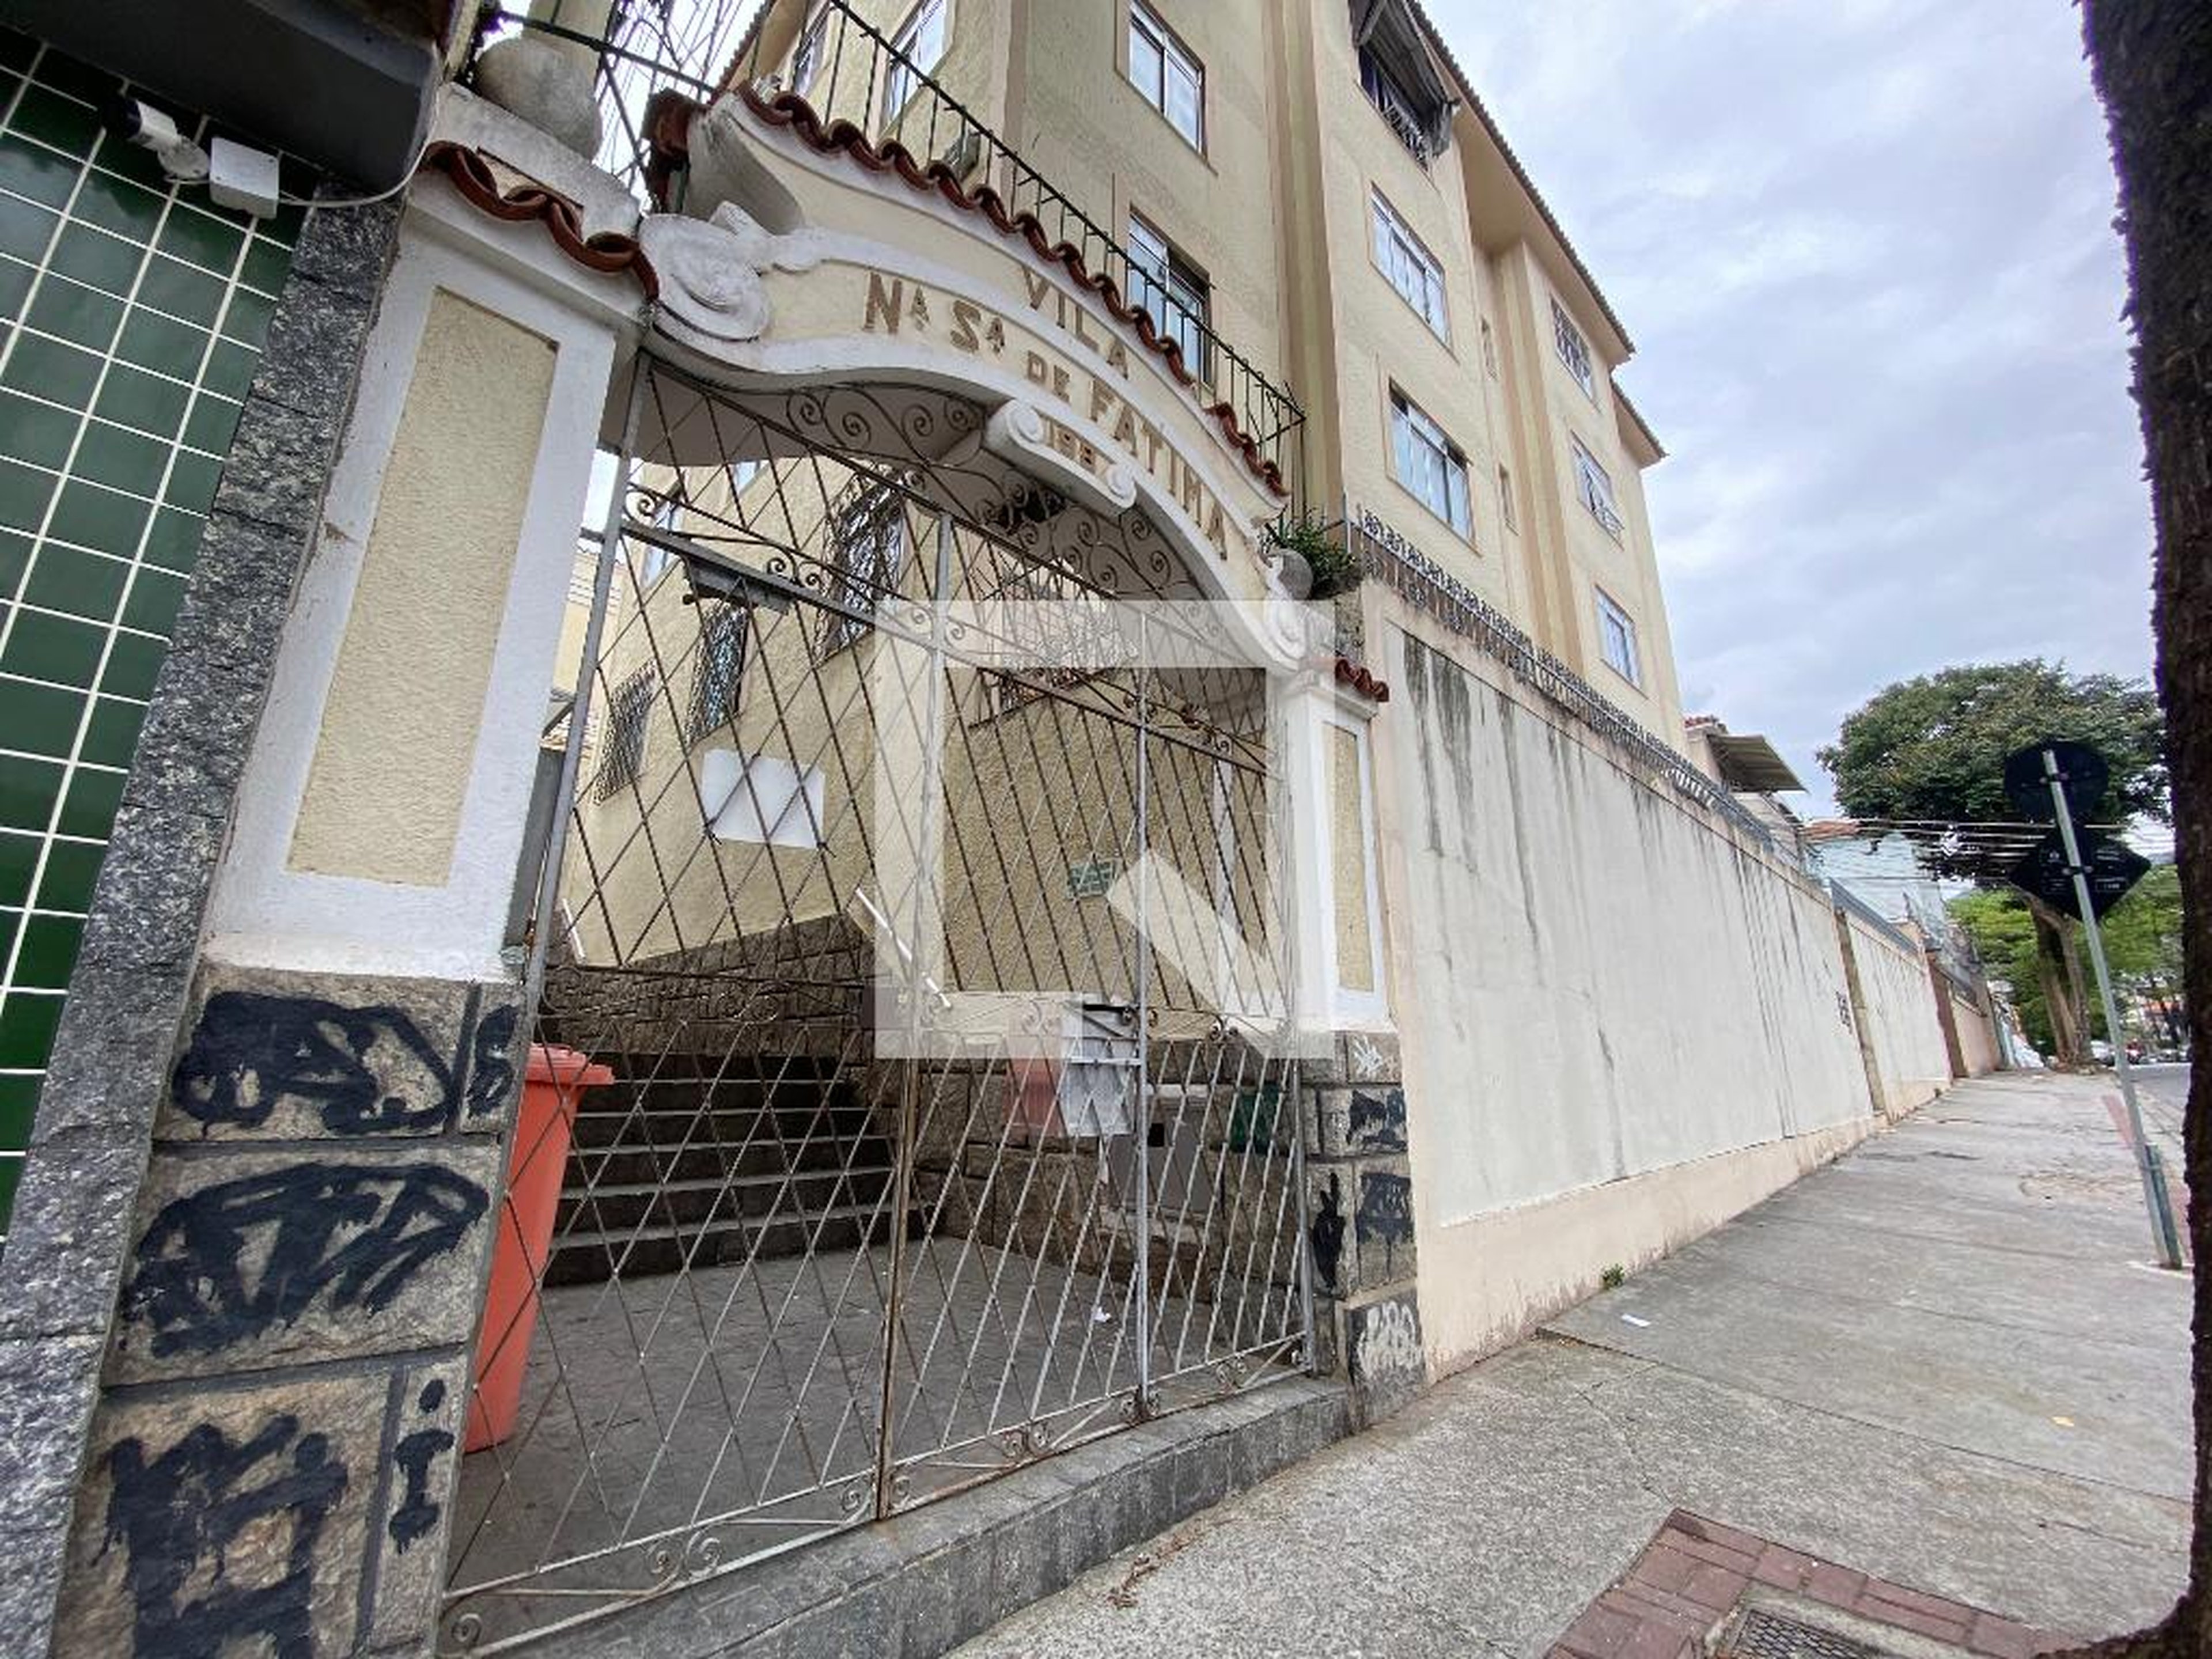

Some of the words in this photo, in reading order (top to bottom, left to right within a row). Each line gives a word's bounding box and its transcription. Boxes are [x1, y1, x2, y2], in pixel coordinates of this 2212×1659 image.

[1022, 266, 1129, 380] VILA
[1027, 350, 1071, 404] DE
[1090, 376, 1229, 562] FATIMA
